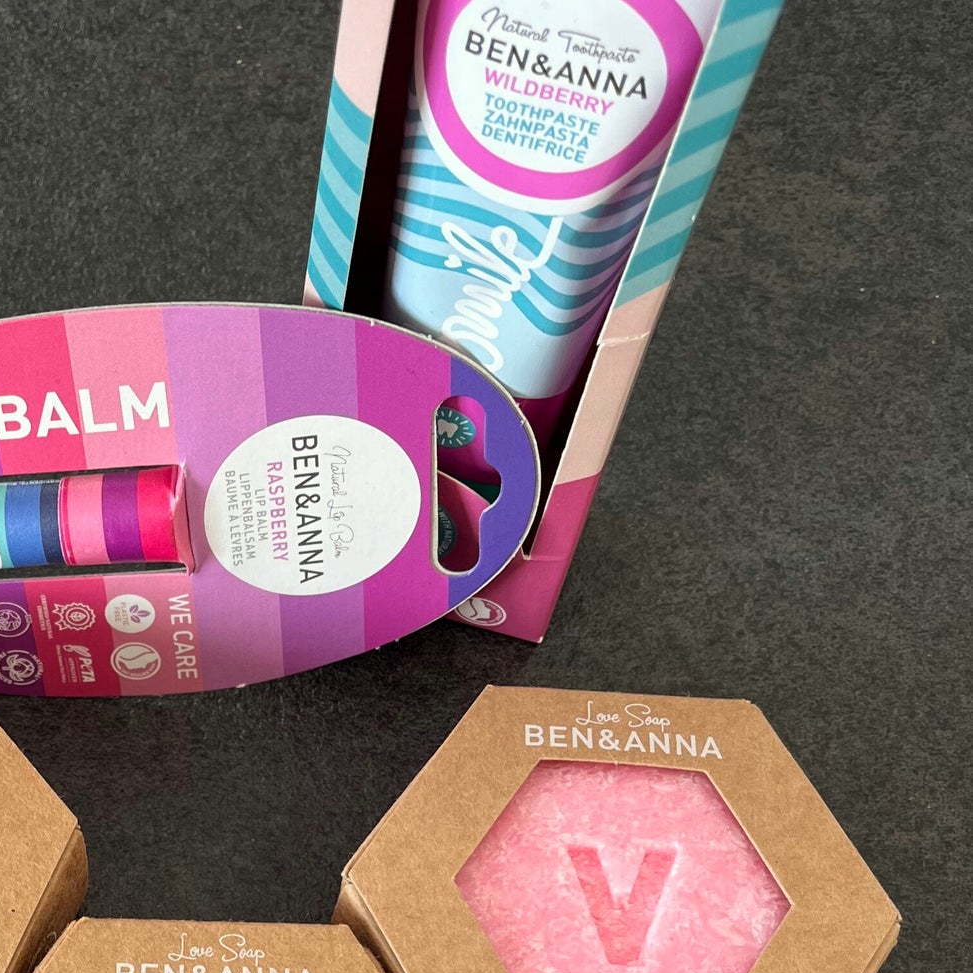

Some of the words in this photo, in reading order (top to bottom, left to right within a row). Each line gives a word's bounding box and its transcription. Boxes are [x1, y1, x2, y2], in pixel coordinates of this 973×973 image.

[481, 6, 550, 43] Natural
[557, 30, 640, 64] Toothpaste
[464, 29, 648, 100] BEN&ANNA
[484, 66, 614, 116] WILDBERRY
[484, 92, 600, 136] TOOTHPASTE
[484, 108, 590, 150] ZAHNPASTA
[481, 124, 587, 164] DENTIFRICE
[225, 470, 239, 511] BAUME
[324, 445, 352, 497] Natural
[239, 472, 256, 560] LIPPENBALSAM
[254, 488, 266, 506] LIP
[267, 461, 289, 561] RASPBERRY
[291, 434, 325, 584] BEN&ANNA
[327, 499, 353, 522] Lip
[256, 511, 269, 541] BALM
[329, 523, 355, 559] Balm
[120, 601, 130, 627] PLASTIC
[168, 593, 192, 625] WE
[173, 630, 199, 680] CARE
[575, 700, 620, 726] Love
[624, 703, 670, 732] Soap
[524, 724, 723, 760] BEN&ANNA
[567, 846, 678, 966] V
[168, 932, 214, 961] Love
[218, 933, 265, 967] Soap
